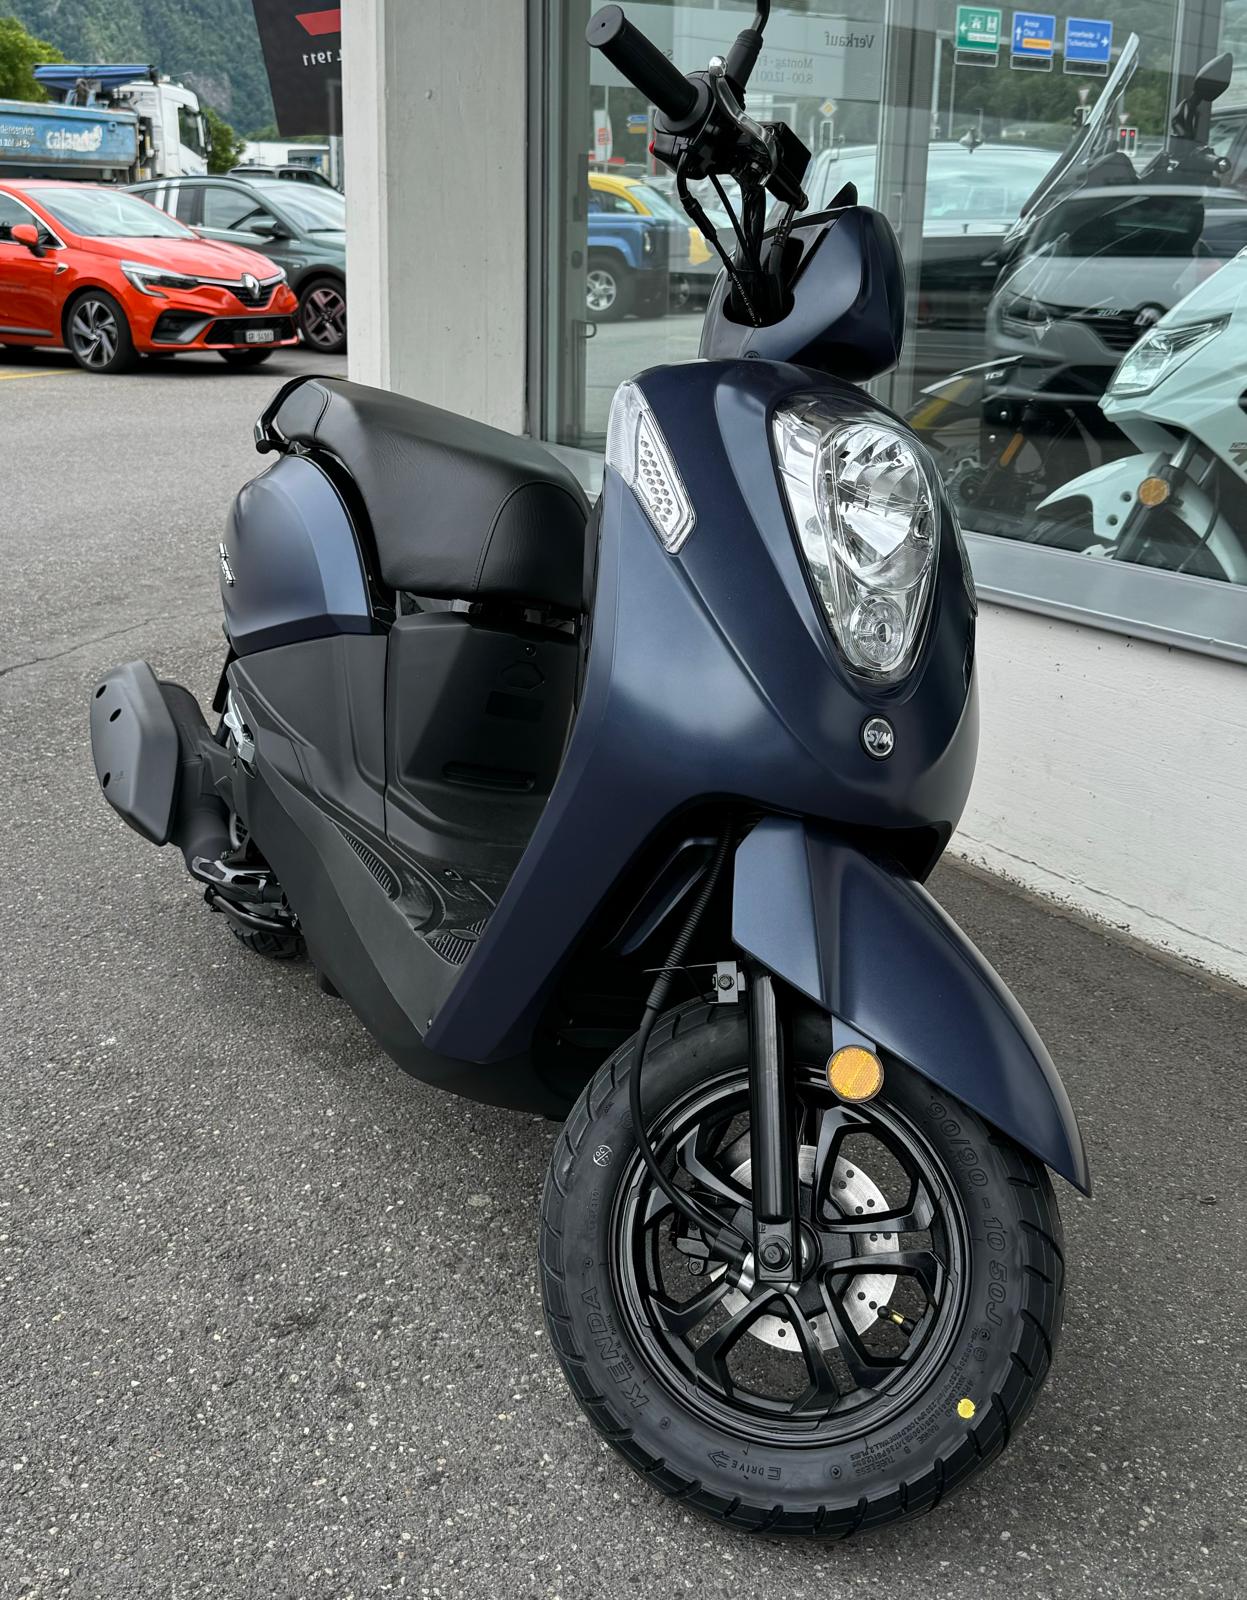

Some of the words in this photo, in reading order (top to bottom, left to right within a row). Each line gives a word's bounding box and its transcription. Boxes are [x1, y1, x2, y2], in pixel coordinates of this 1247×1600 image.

[867, 729, 893, 746] SYM
[927, 1101, 989, 1188] 90/90
[581, 1286, 649, 1409] KENDA
[731, 1459, 765, 1476] DRIVE
